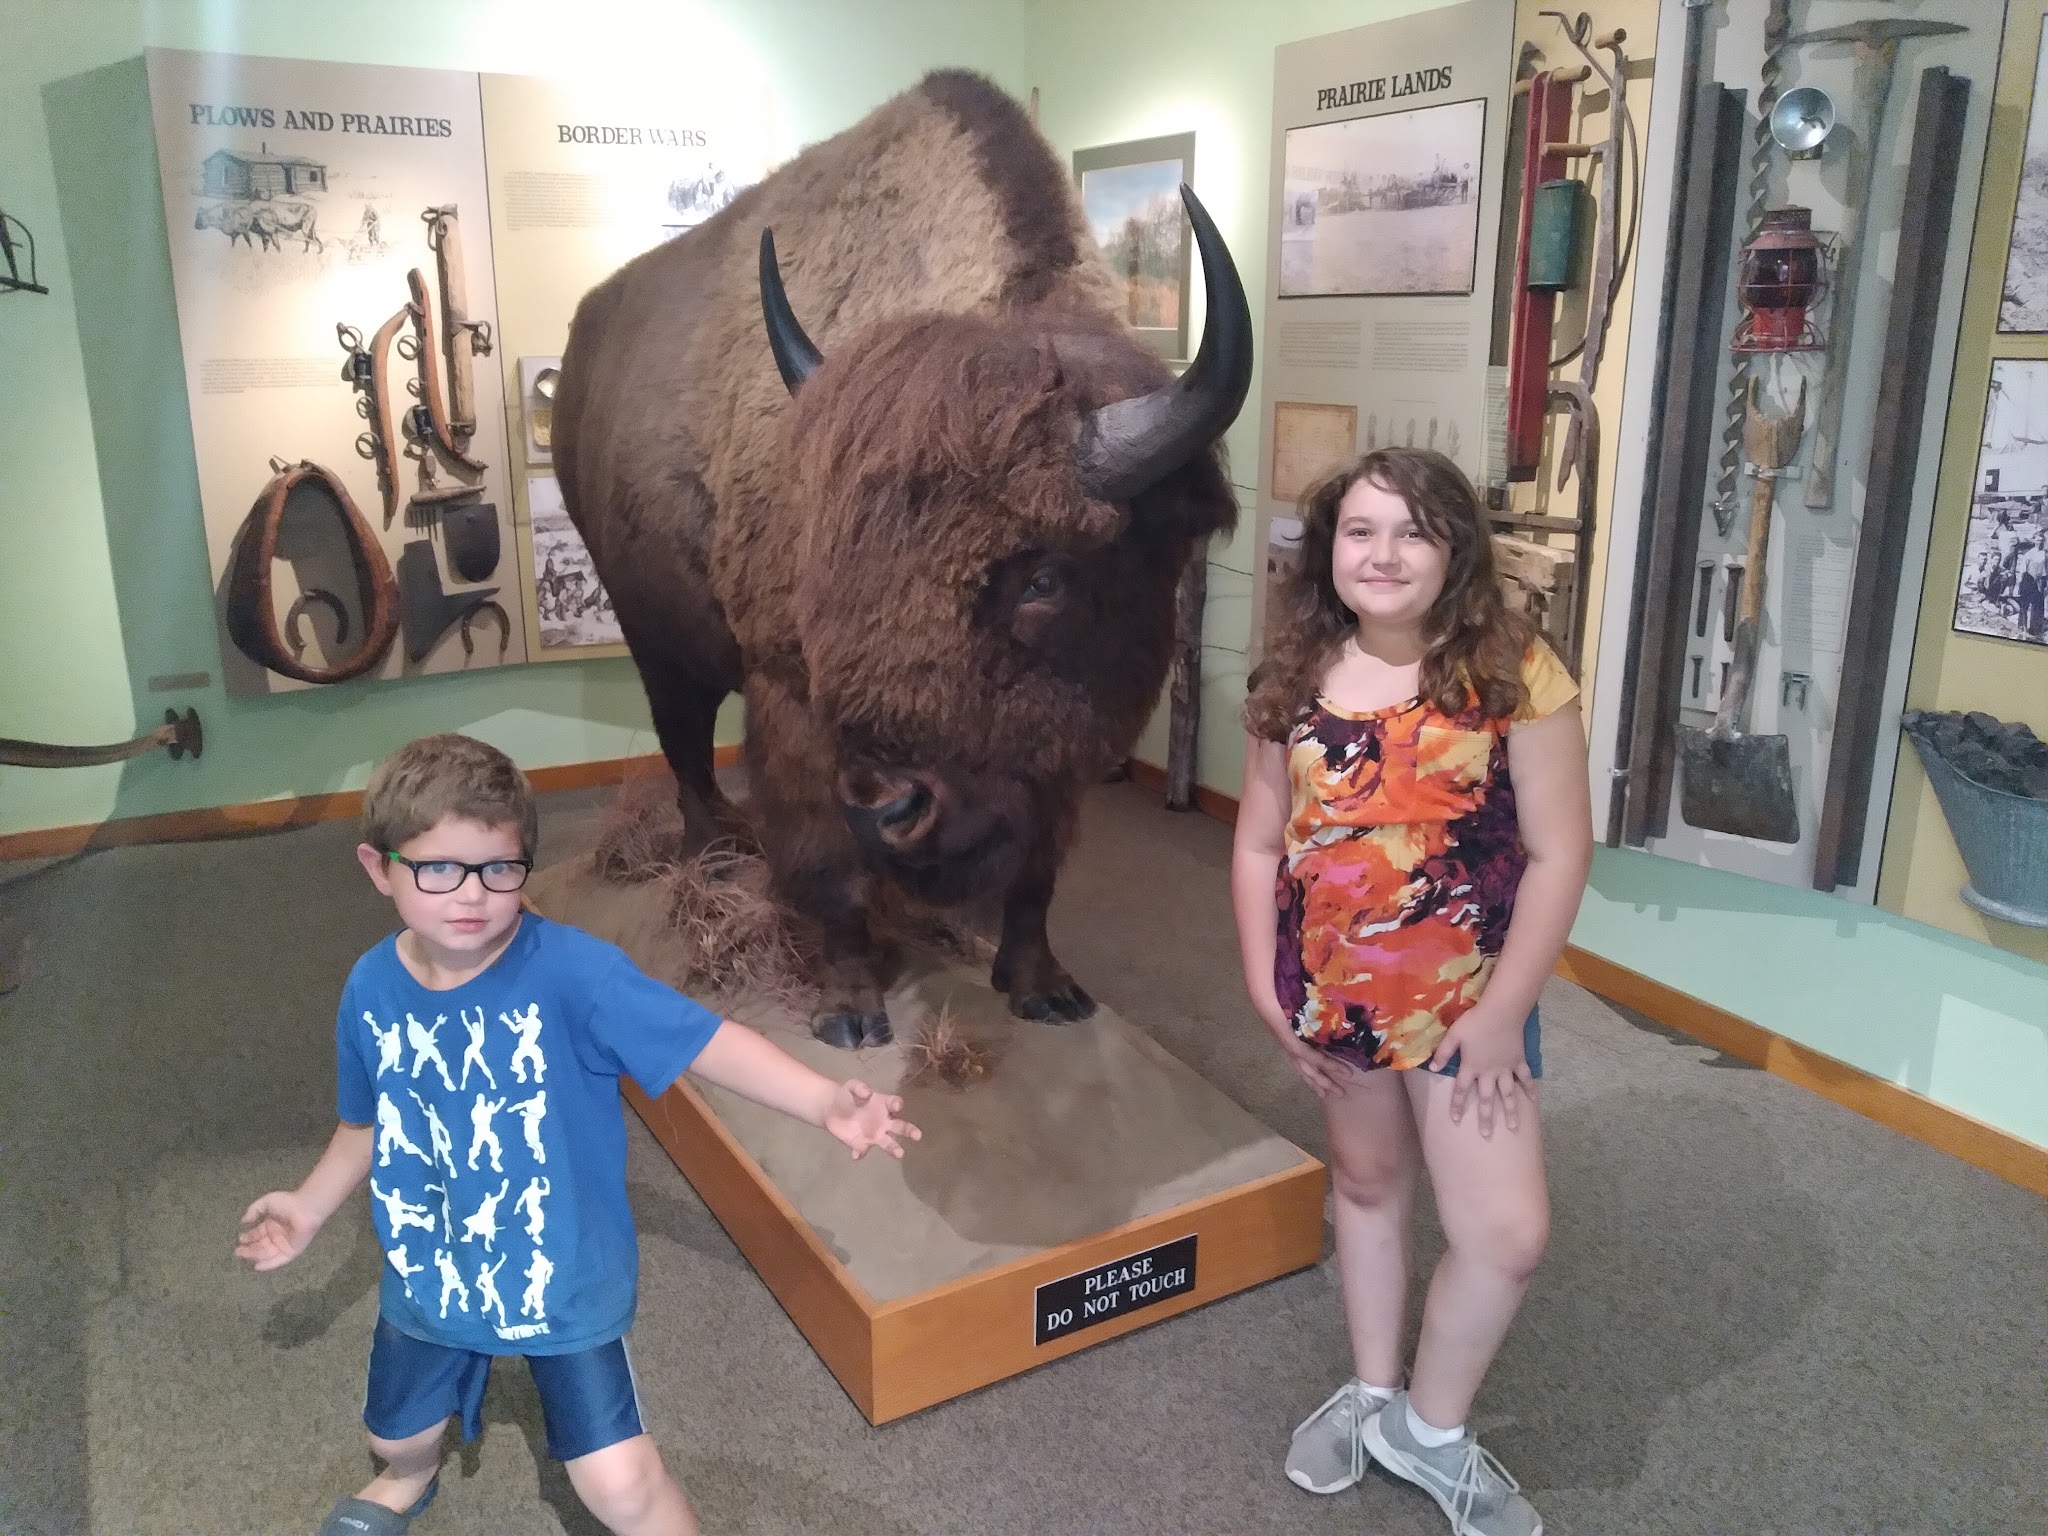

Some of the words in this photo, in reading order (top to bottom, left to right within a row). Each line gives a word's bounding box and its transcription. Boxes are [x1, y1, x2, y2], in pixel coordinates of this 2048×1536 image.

[1316, 78, 1386, 111] PRAIRIE
[1391, 66, 1452, 98] LANDS
[189, 104, 276, 128] PLOWS
[283, 110, 334, 131] AND
[340, 113, 452, 138] PRAIRIES
[557, 124, 642, 145] BORDER
[649, 128, 707, 147] WARS
[1084, 1257, 1153, 1295] PLEASE
[1047, 1308, 1073, 1331] DO
[1083, 1291, 1120, 1318] NOT
[1129, 1268, 1186, 1301] TOUCH
